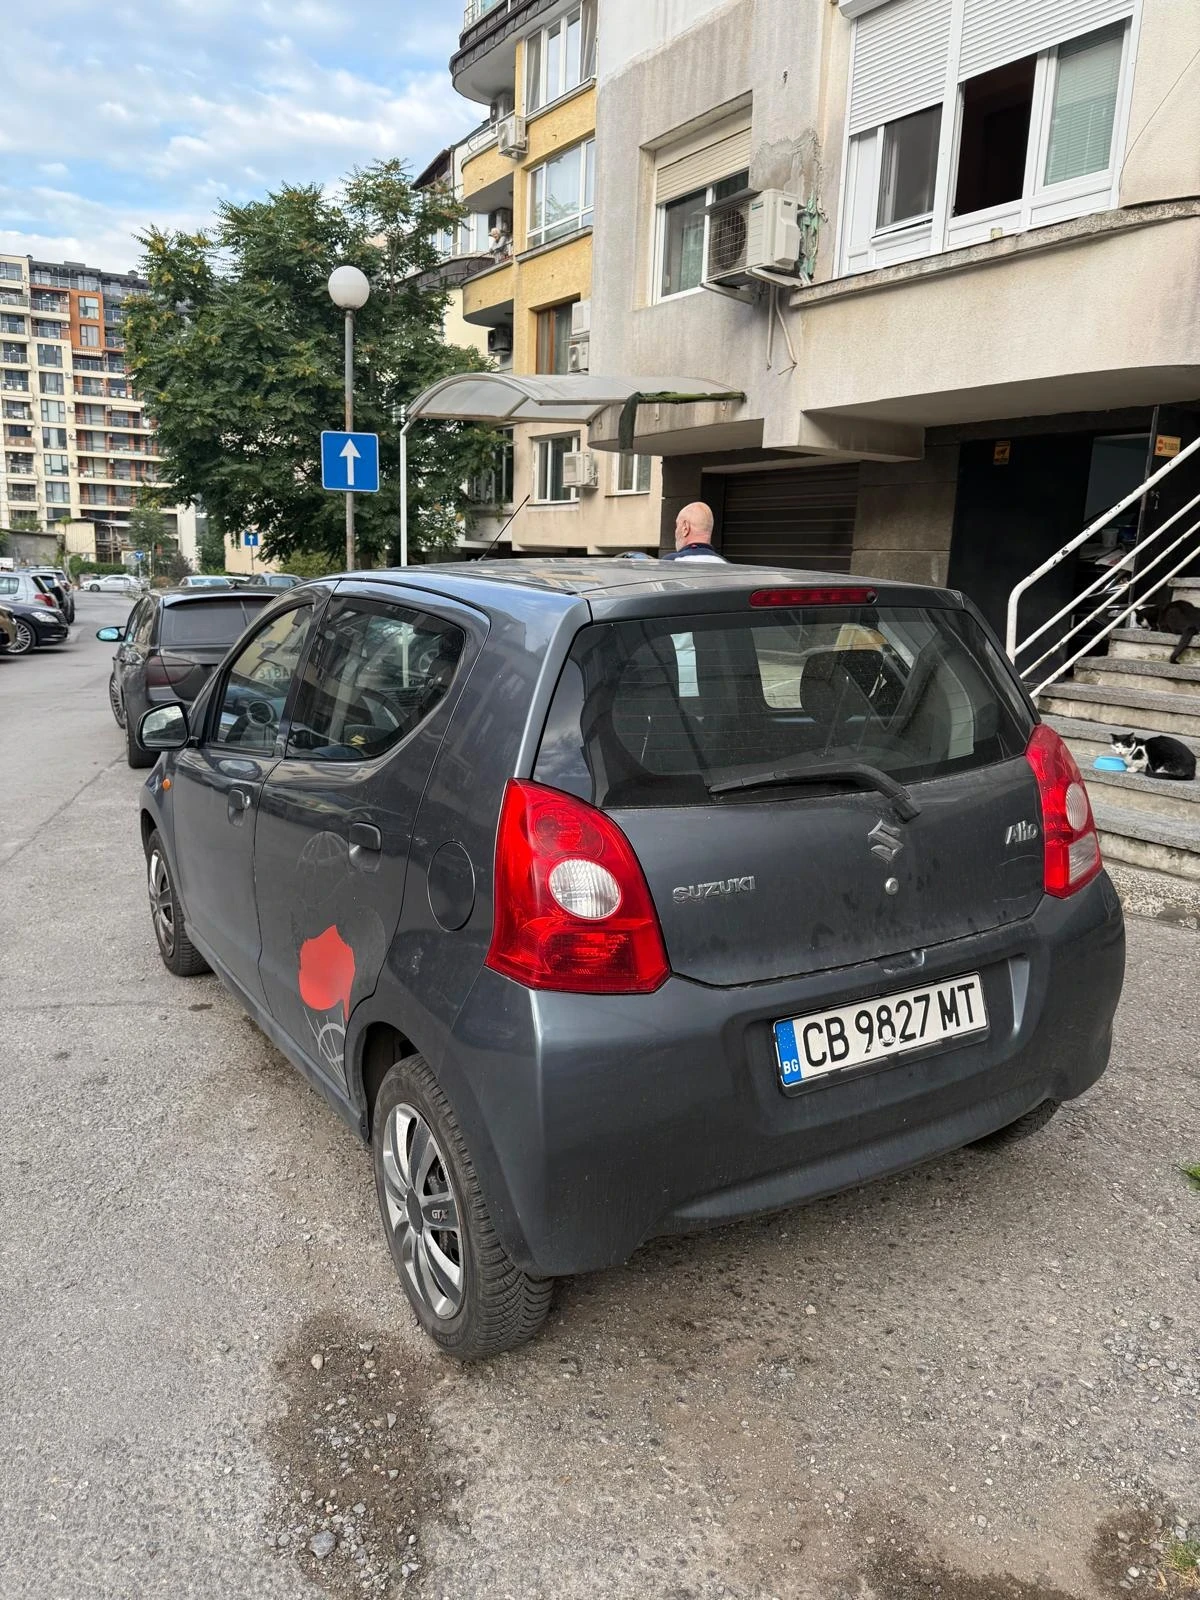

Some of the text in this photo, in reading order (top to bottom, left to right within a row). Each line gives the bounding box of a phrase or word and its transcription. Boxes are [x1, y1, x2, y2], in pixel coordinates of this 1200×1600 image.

[1004, 820, 1039, 845] Alto
[672, 876, 756, 903] SUZUKI
[802, 982, 975, 1067] CB 9827 MT
[781, 1058, 799, 1075] BG
